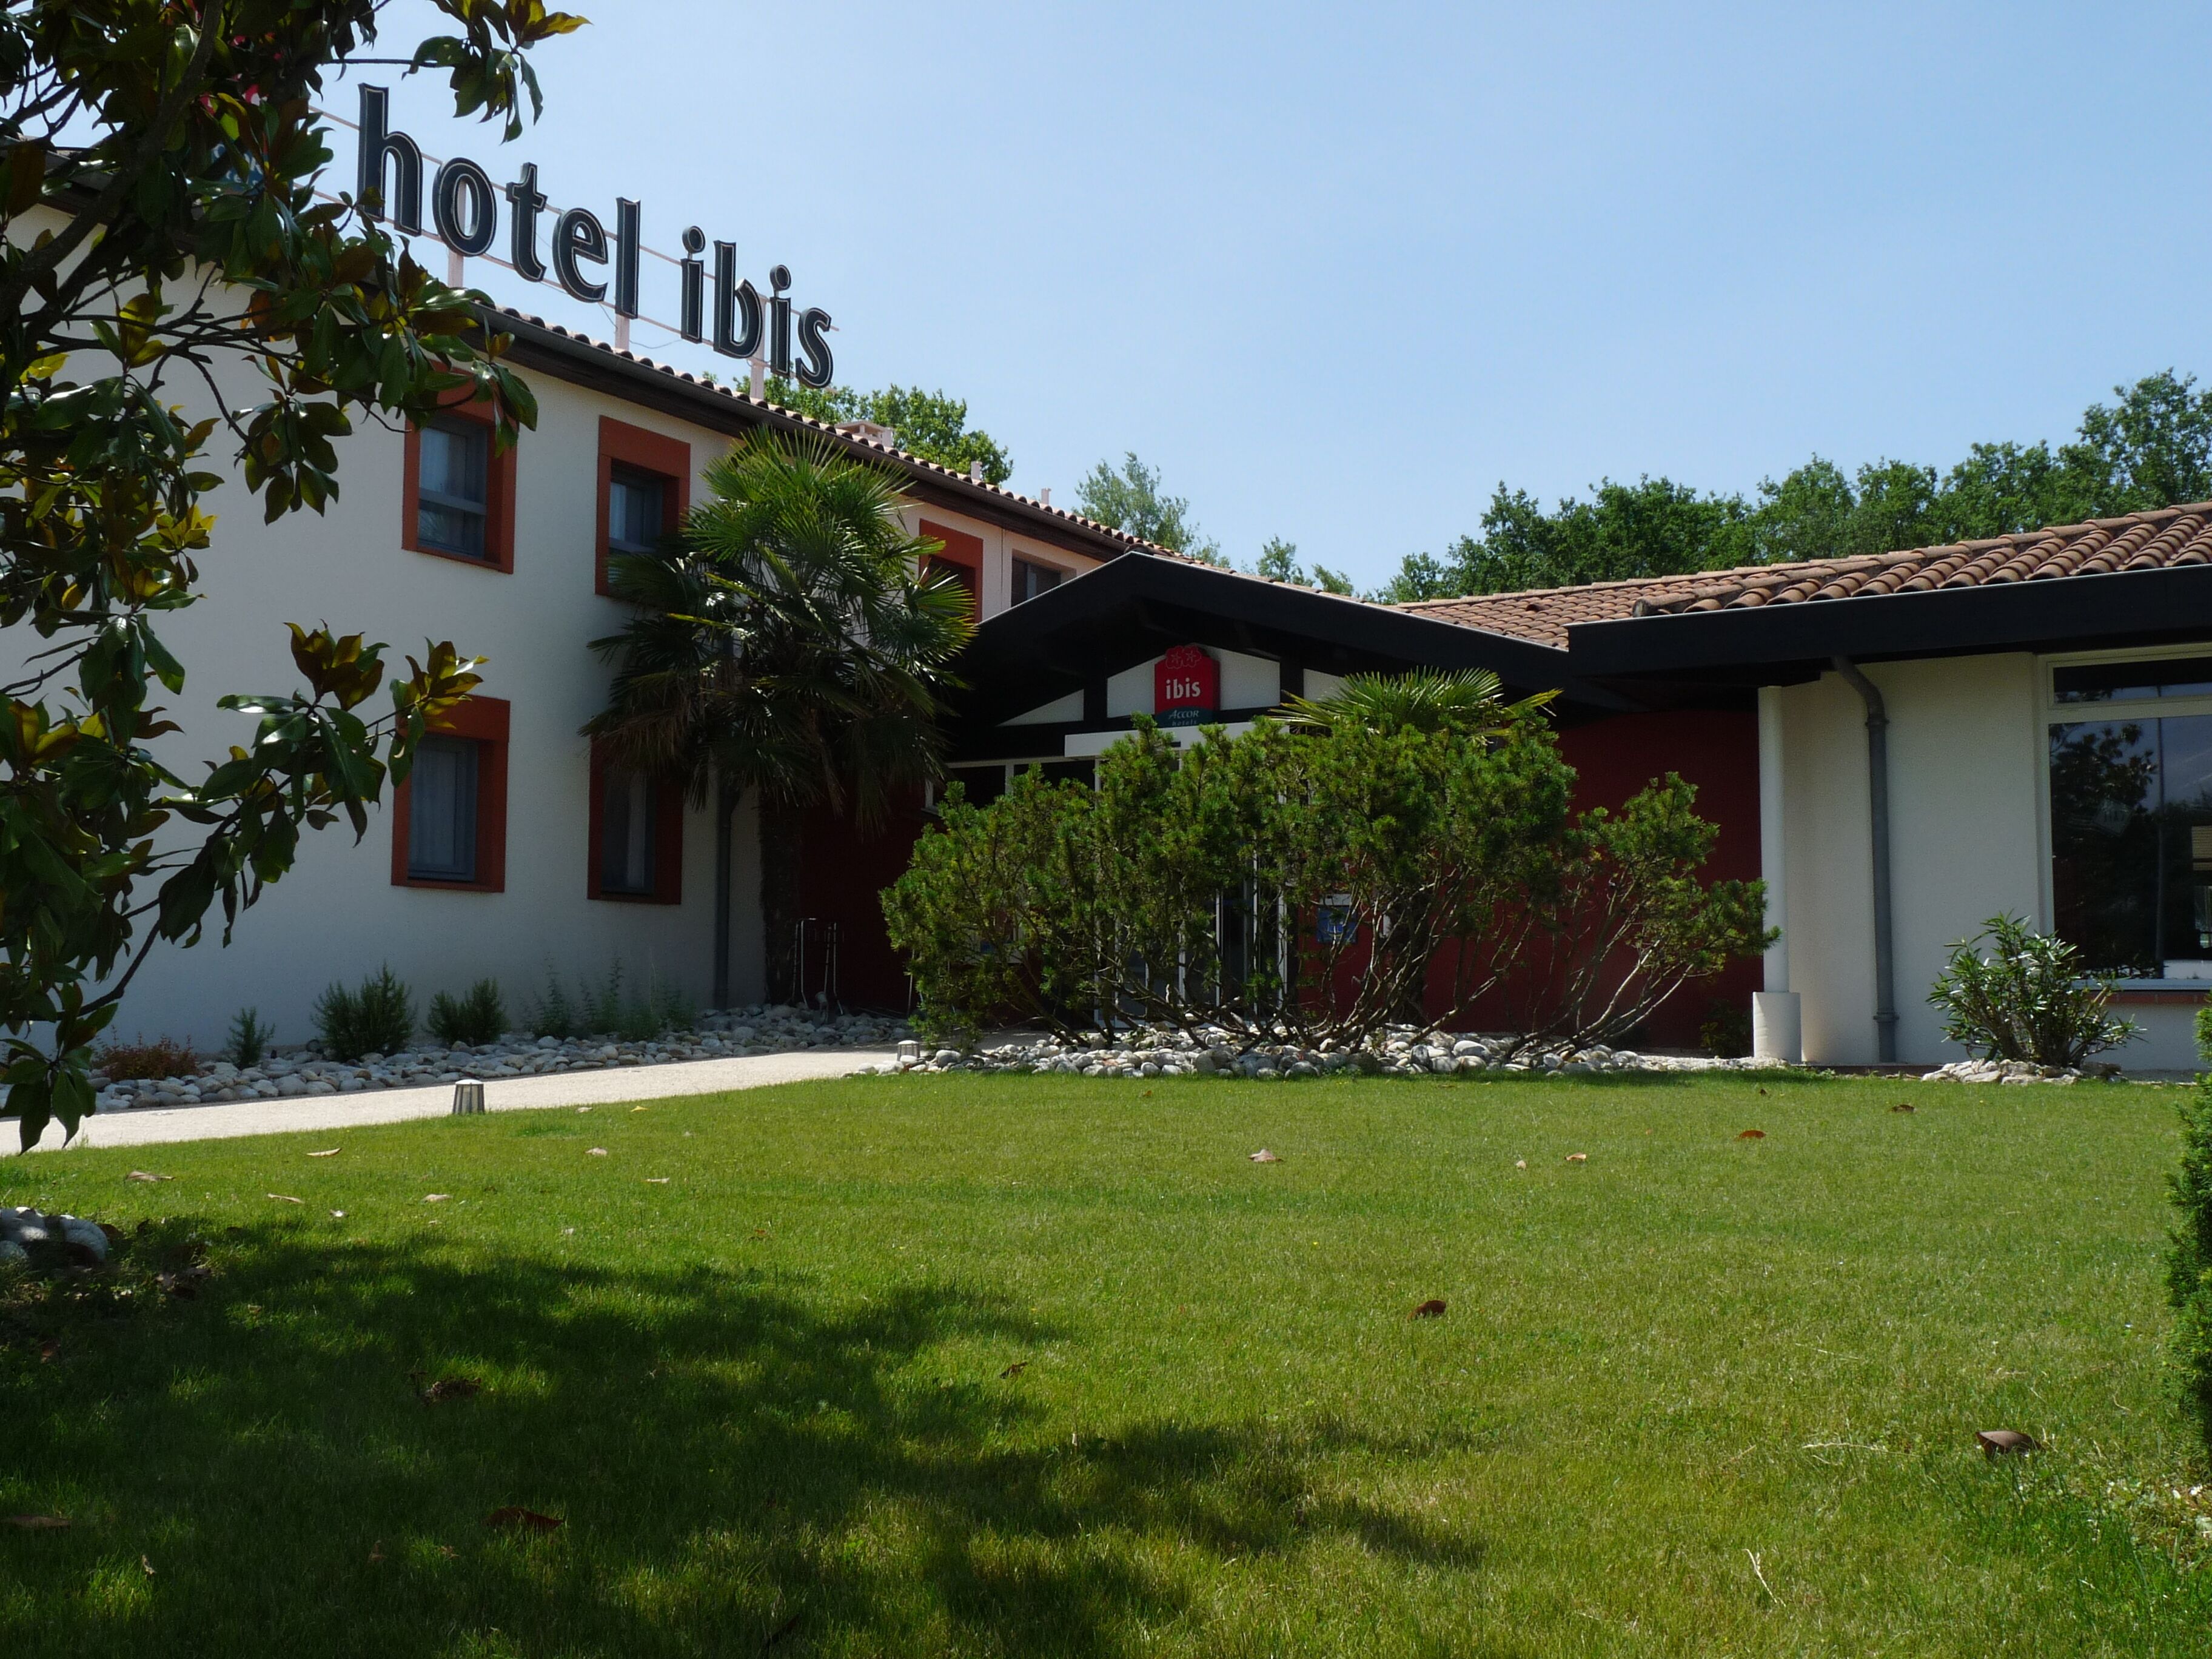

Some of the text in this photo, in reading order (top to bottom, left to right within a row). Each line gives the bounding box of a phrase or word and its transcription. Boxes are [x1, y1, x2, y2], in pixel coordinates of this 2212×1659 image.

[357, 83, 834, 389] hotel ibis
[1165, 677, 1201, 700] ibis
